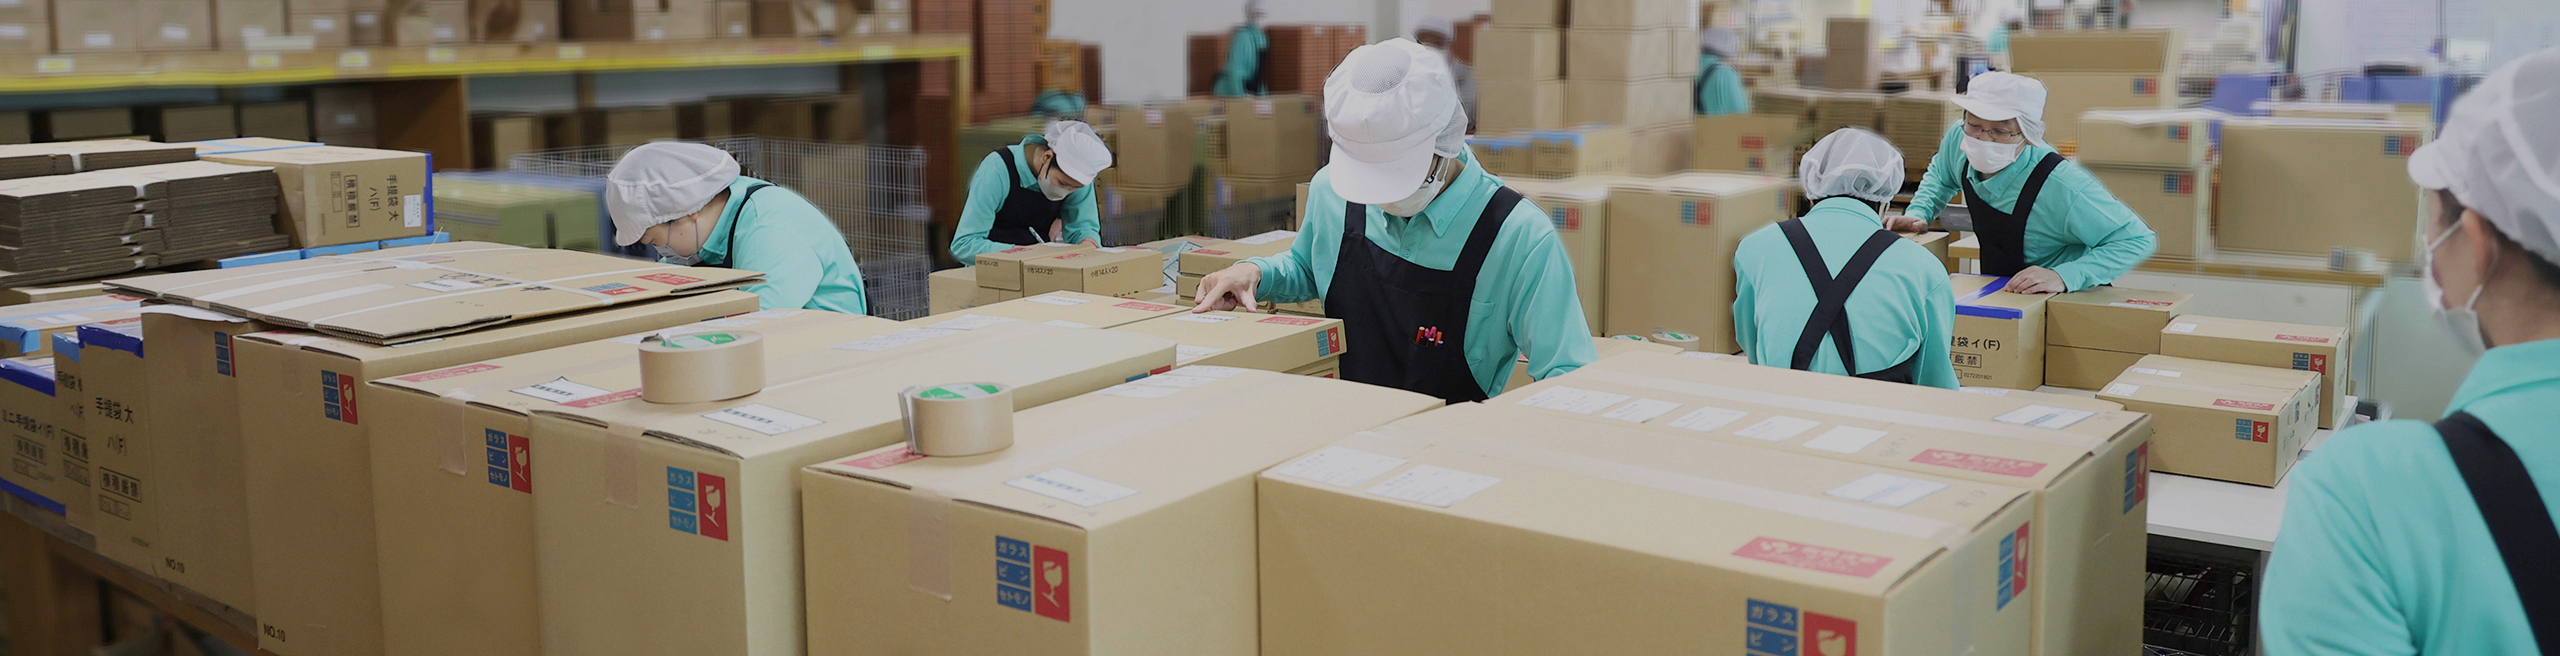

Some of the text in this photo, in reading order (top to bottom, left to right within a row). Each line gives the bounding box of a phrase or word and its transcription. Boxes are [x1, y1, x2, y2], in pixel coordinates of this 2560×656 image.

[998, 541, 1028, 559] ガラス
[1749, 604, 1795, 627] ガラス
